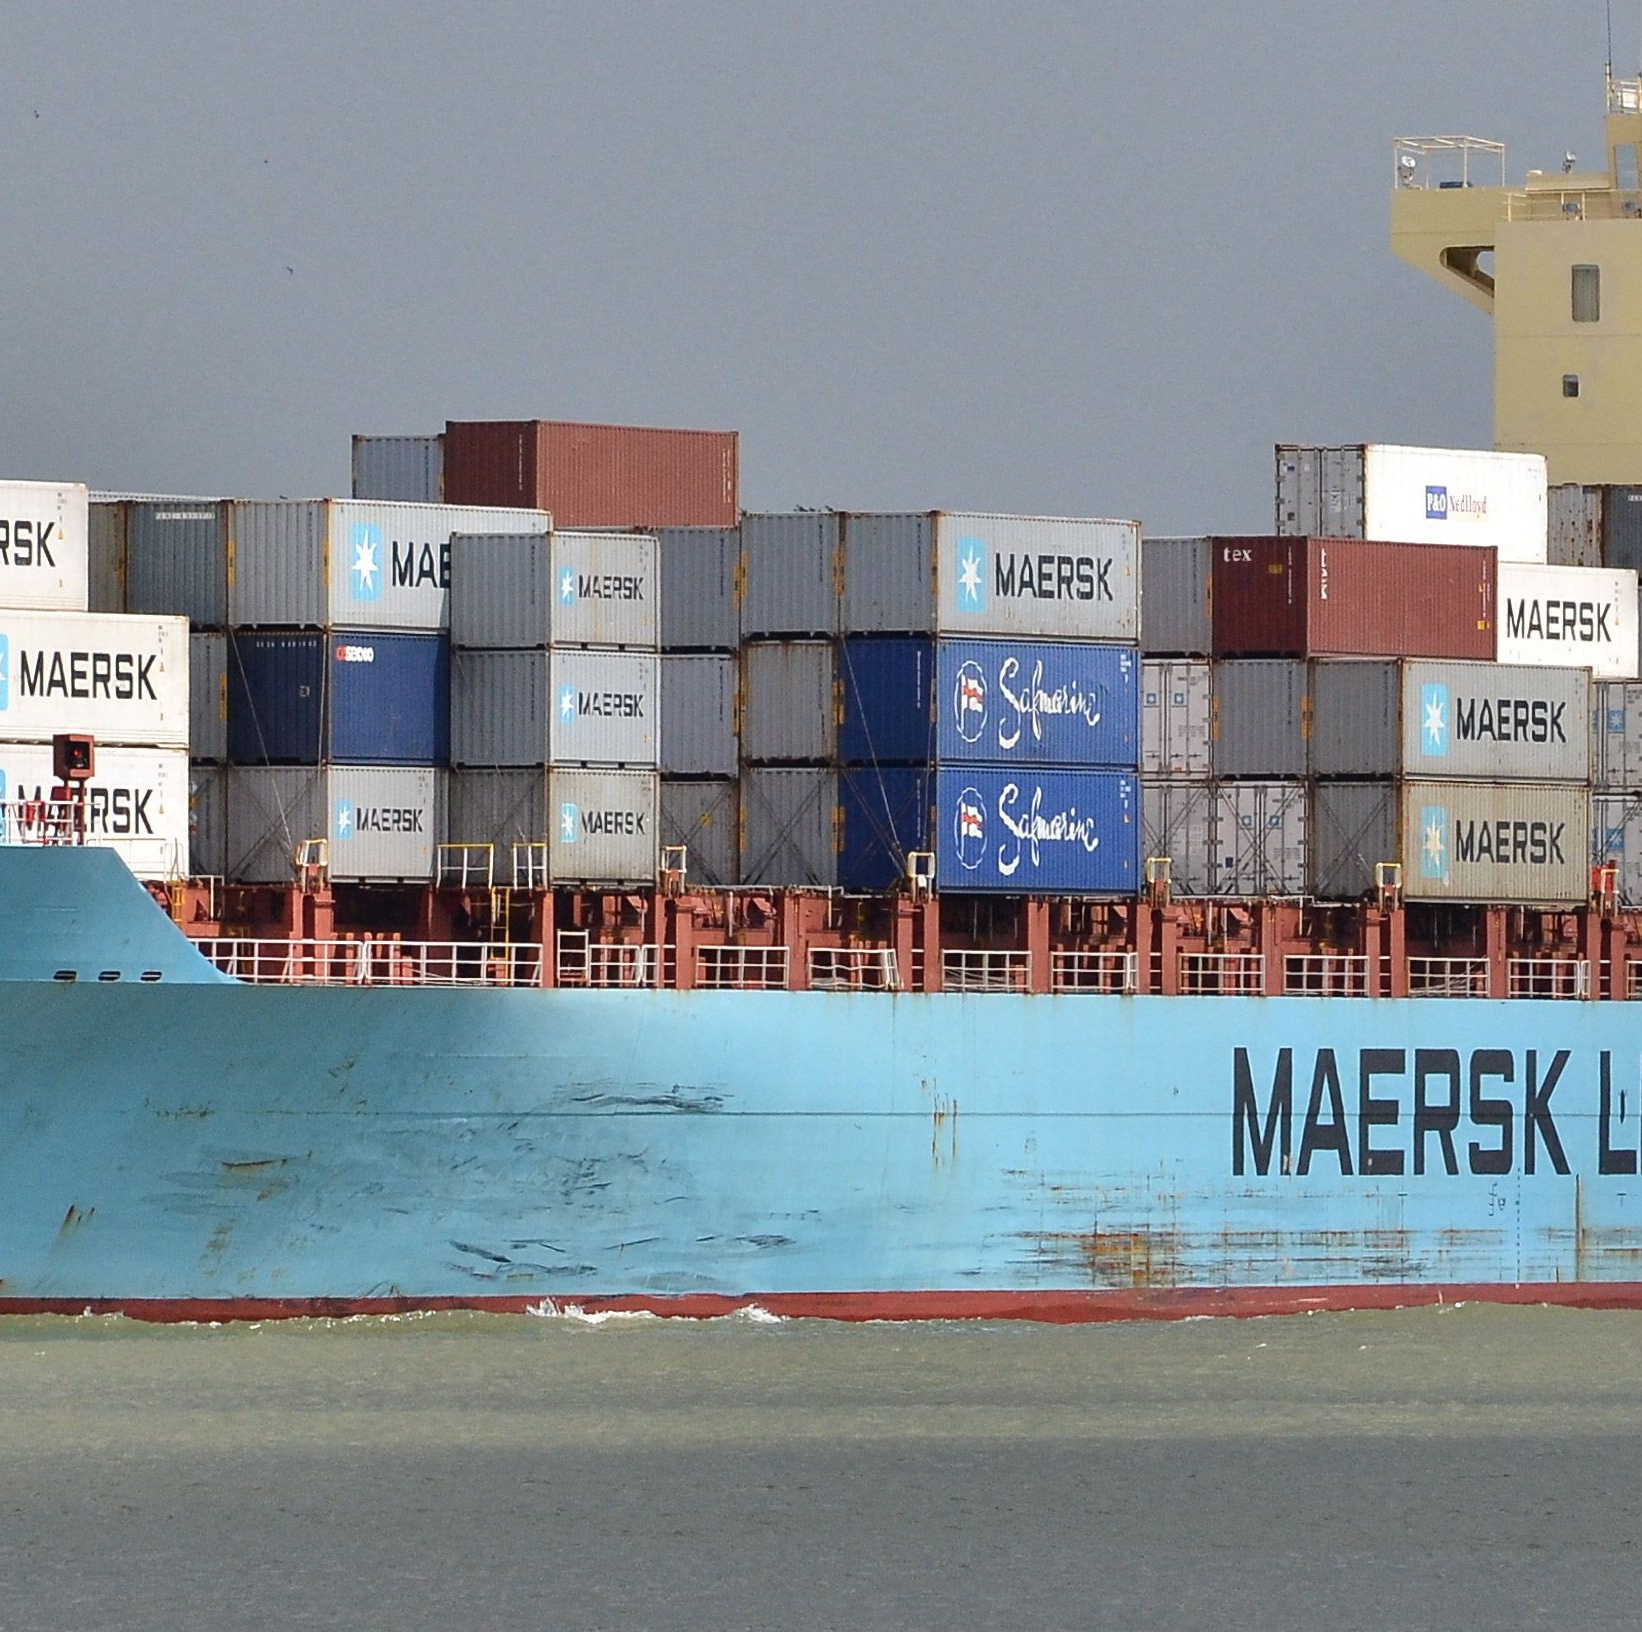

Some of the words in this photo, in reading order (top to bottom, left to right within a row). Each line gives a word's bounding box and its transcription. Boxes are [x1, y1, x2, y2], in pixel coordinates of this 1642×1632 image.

[1426, 493, 1446, 512] P&O
[1449, 494, 1486, 518] Nedlloyd
[392, 540, 451, 588] MAE
[1223, 547, 1252, 562] tex
[579, 575, 643, 599] MAERSK
[996, 553, 1113, 601] MAERSK
[1507, 598, 1611, 642] MAERSK
[21, 651, 157, 700] MAERSK
[579, 692, 643, 717] MAERSK
[999, 657, 1100, 749] Safmarine
[1457, 698, 1566, 743] MAERSK
[357, 808, 422, 832] MAERSK
[582, 811, 645, 835] MAERSK
[999, 784, 1098, 876] Safmarine
[1456, 820, 1565, 864] MAERSK
[1233, 1048, 1571, 1176] MAERSK
